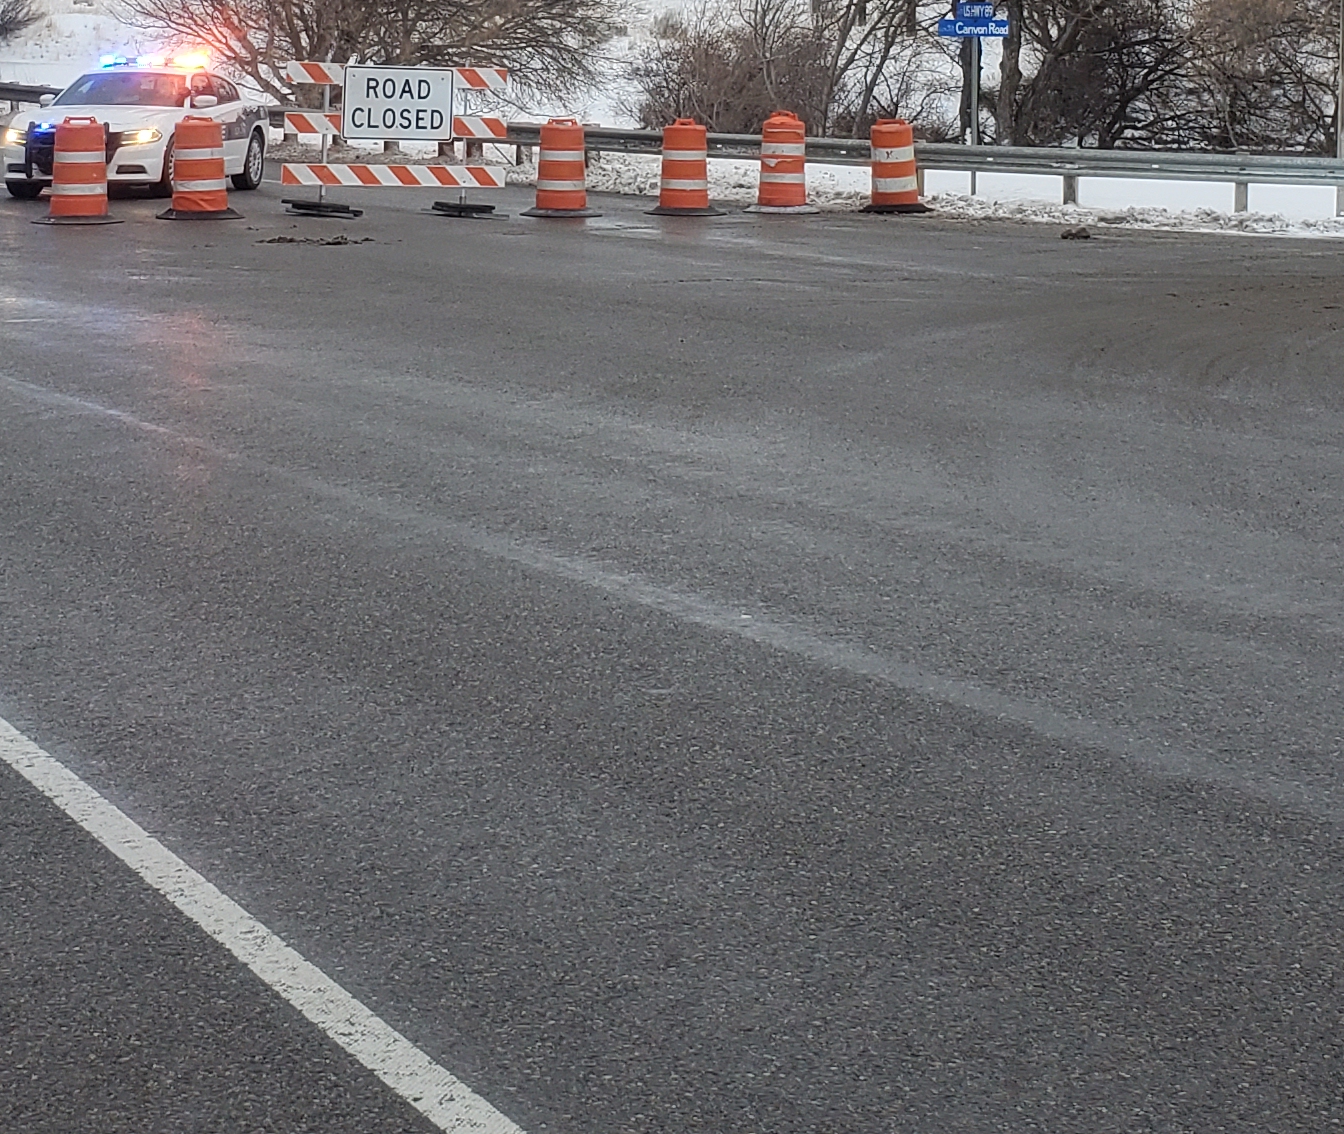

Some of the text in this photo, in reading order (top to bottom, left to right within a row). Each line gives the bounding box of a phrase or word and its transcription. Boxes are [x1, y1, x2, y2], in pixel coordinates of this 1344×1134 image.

[984, 5, 993, 17] 89
[988, 22, 1009, 34] Road
[366, 78, 431, 100] ROAD
[351, 108, 444, 130] CLOSED
